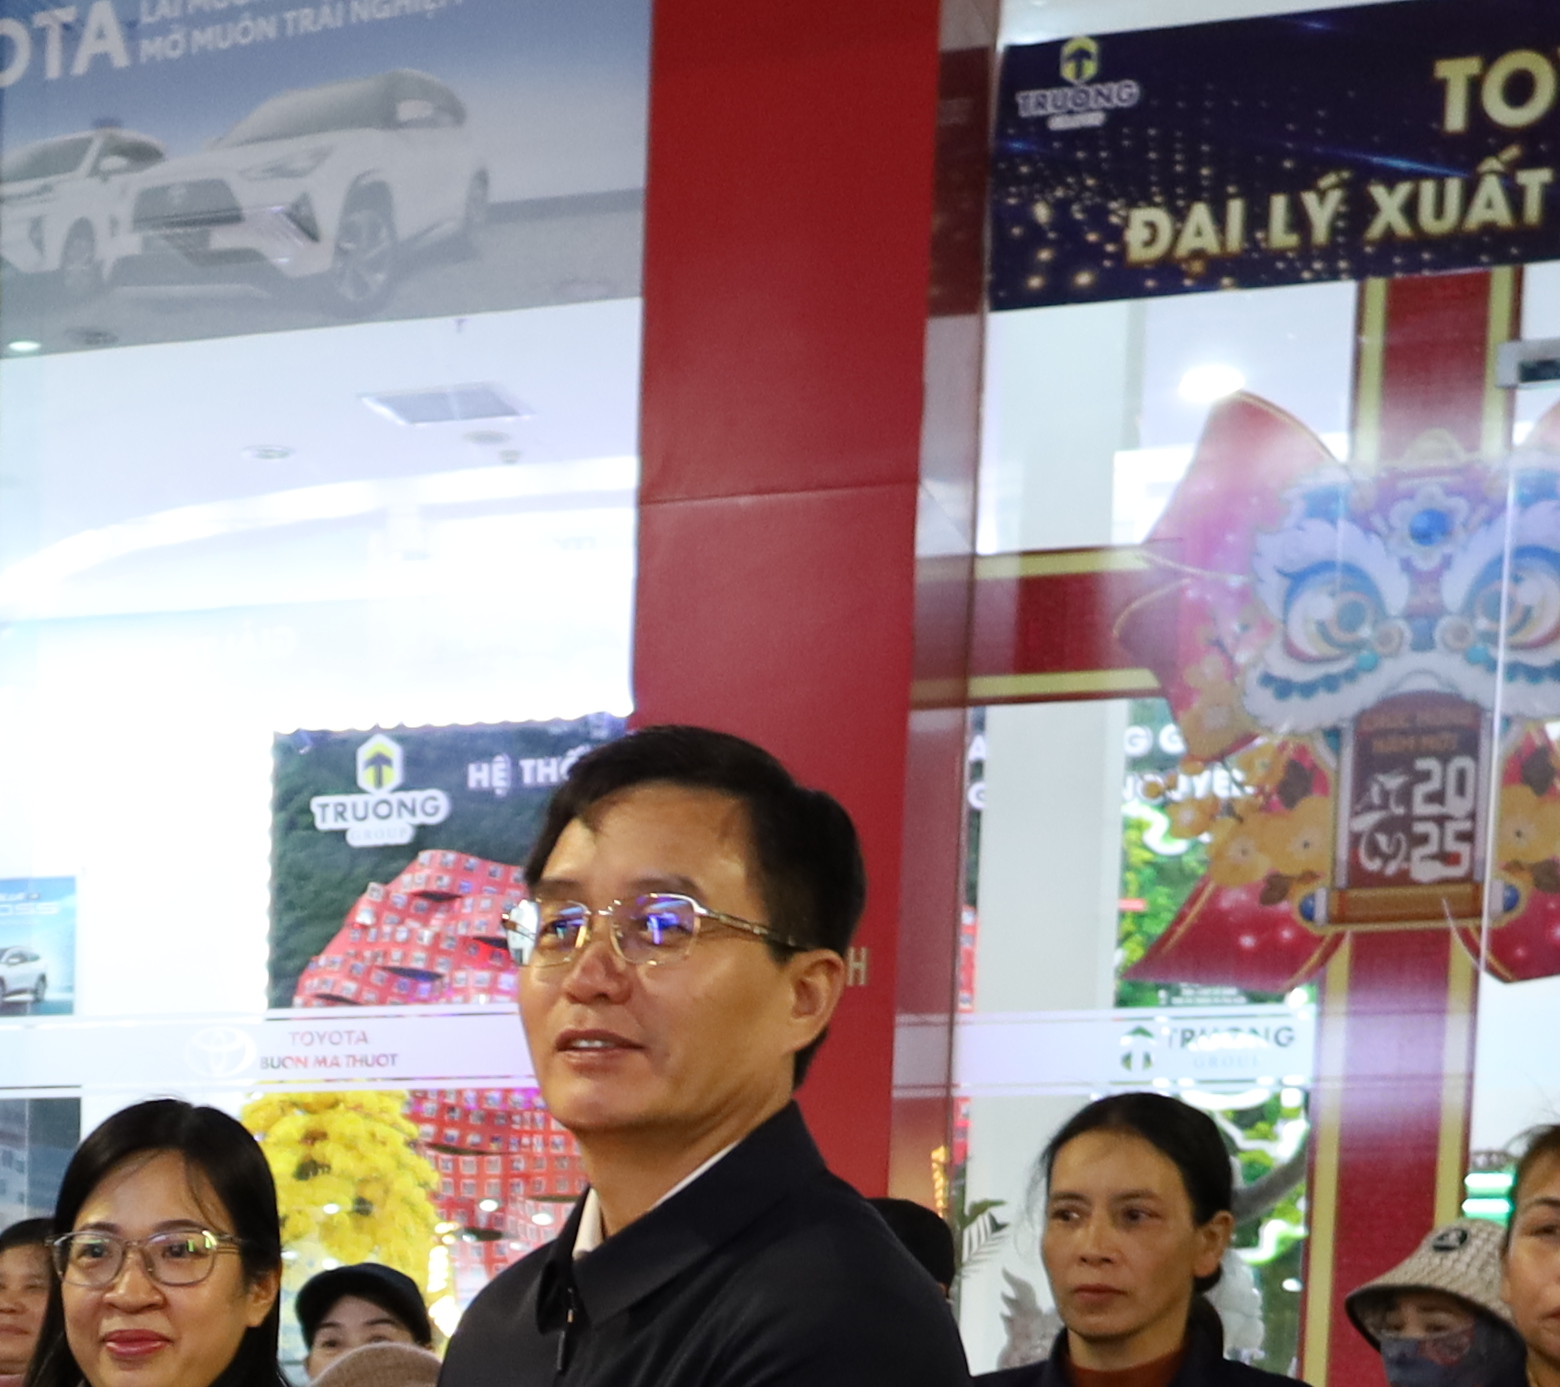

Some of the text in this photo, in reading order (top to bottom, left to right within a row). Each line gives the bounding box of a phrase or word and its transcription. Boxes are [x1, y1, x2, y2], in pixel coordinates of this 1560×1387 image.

[1125, 201, 1247, 277] ĐẠI
[1267, 170, 1352, 252] LÝ
[1365, 144, 1554, 242] XUẤT
[467, 752, 511, 796] HỆ
[1412, 756, 1476, 819] 20
[315, 795, 442, 824] TRUONG
[1410, 820, 1473, 882] 25
[288, 1030, 368, 1047] TOYOTA
[261, 1053, 398, 1070] BUON MA THUOT
